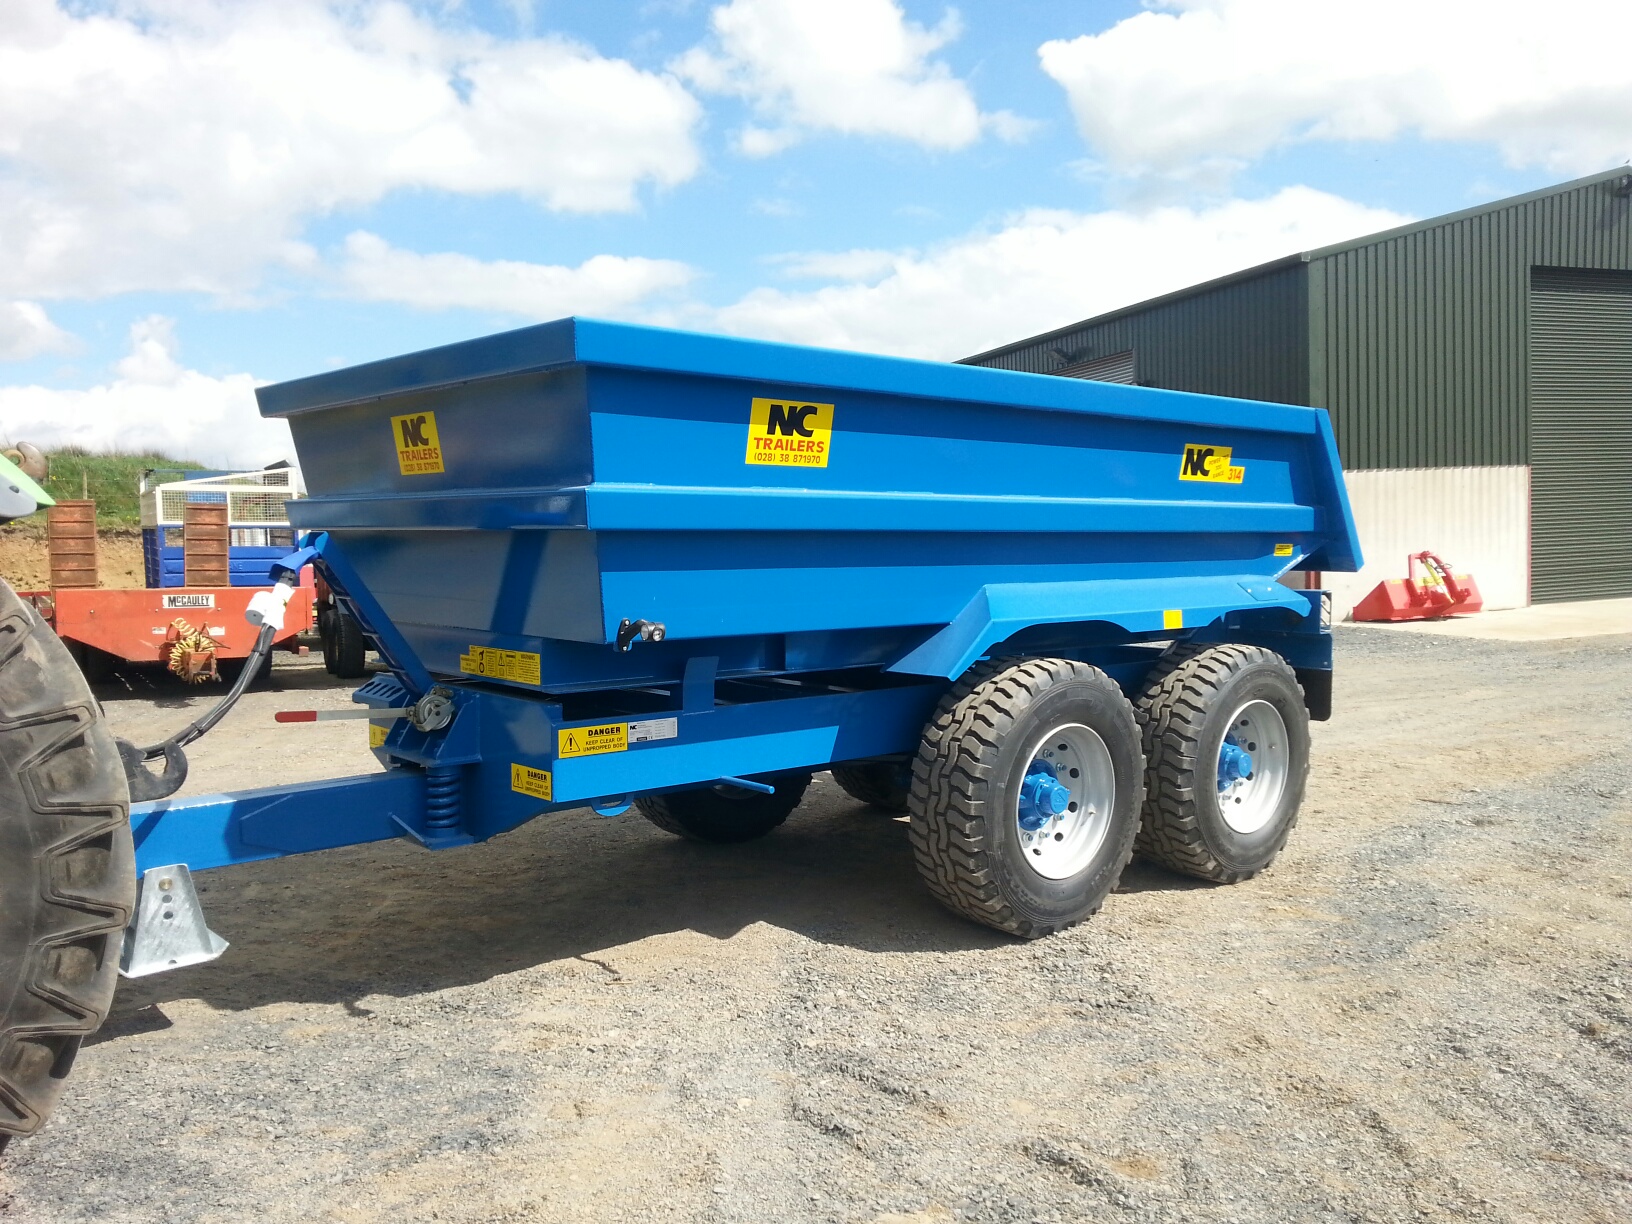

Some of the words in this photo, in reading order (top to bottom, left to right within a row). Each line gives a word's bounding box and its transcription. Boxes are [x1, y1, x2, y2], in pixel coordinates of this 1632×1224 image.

[767, 404, 818, 437] NC
[401, 416, 429, 448] NC
[754, 437, 824, 453] TRAILERS
[400, 448, 439, 462] TRAILERS
[754, 453, 776, 462] (028)
[780, 454, 789, 463] 38
[793, 455, 820, 464] 871970
[1182, 448, 1215, 477] NC
[1228, 468, 1242, 480] 314
[588, 727, 621, 737] DANGER
[583, 744, 611, 752] UNPROPPED
[527, 770, 547, 781] DANGER
